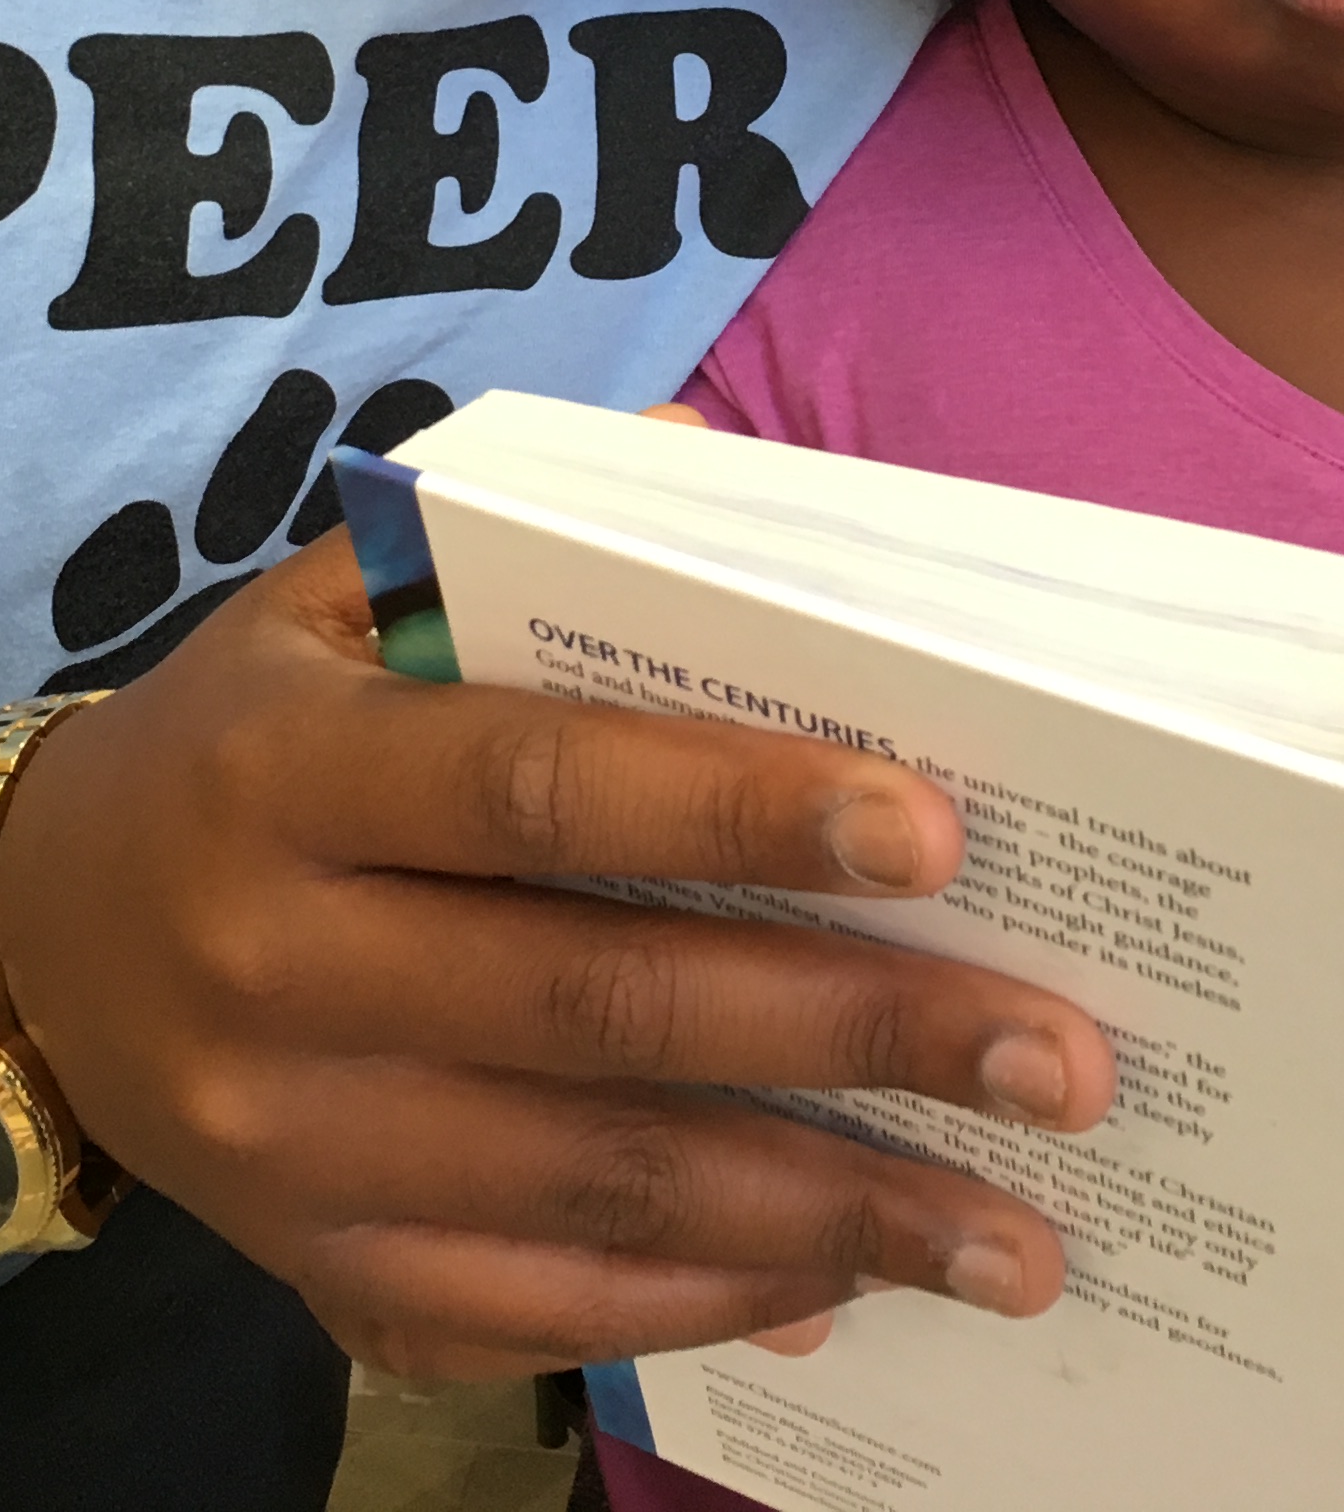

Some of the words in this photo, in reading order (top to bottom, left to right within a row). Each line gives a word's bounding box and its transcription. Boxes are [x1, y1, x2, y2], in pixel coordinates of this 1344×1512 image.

[528, 618, 620, 666] OVER
[623, 648, 692, 691] THE
[916, 756, 955, 781] the
[964, 774, 1079, 826] universal
[1089, 816, 1167, 856] truths
[1176, 847, 1252, 886] about
[536, 648, 584, 679] God
[592, 670, 633, 696] and
[965, 798, 1026, 833] Bible
[1059, 832, 1099, 859] the
[1108, 852, 1211, 899] courage
[742, 885, 822, 926] noblest
[967, 851, 1043, 889] works
[1050, 881, 1077, 901] of
[1083, 890, 1163, 935] Christ
[1172, 922, 1245, 965] Jesus,
[1029, 847, 1149, 906] prophets,
[1158, 891, 1199, 920] the
[943, 892, 994, 921] who
[1002, 913, 1092, 958] ponder
[1100, 946, 1128, 971] its
[1136, 961, 1242, 1012] timeless
[1007, 885, 1104, 937] brought
[1114, 929, 1239, 988] guidance,
[1187, 1052, 1226, 1078] the
[1198, 1078, 1232, 1104] for
[1134, 1102, 1214, 1145] deeply
[1167, 1091, 1206, 1116] the
[828, 1108, 874, 1137] only
[1053, 1198, 1112, 1231] chart
[1119, 1226, 1143, 1243] of
[1202, 1260, 1248, 1287] and
[944, 1114, 1021, 1153] system
[1028, 1148, 1052, 1164] of
[1058, 1156, 1146, 1207] healing
[1152, 1198, 1196, 1224] and
[1204, 1218, 1276, 1255] ethics
[989, 1149, 1044, 1182] Bible
[1051, 1172, 1090, 1202] has
[1097, 1193, 1152, 1227] been
[1162, 1223, 1198, 1246] my
[1204, 1240, 1258, 1273] only
[1129, 1167, 1155, 1185] of
[1160, 1176, 1276, 1234] Christian
[1118, 1306, 1160, 1332] and
[1198, 1316, 1230, 1339] for
